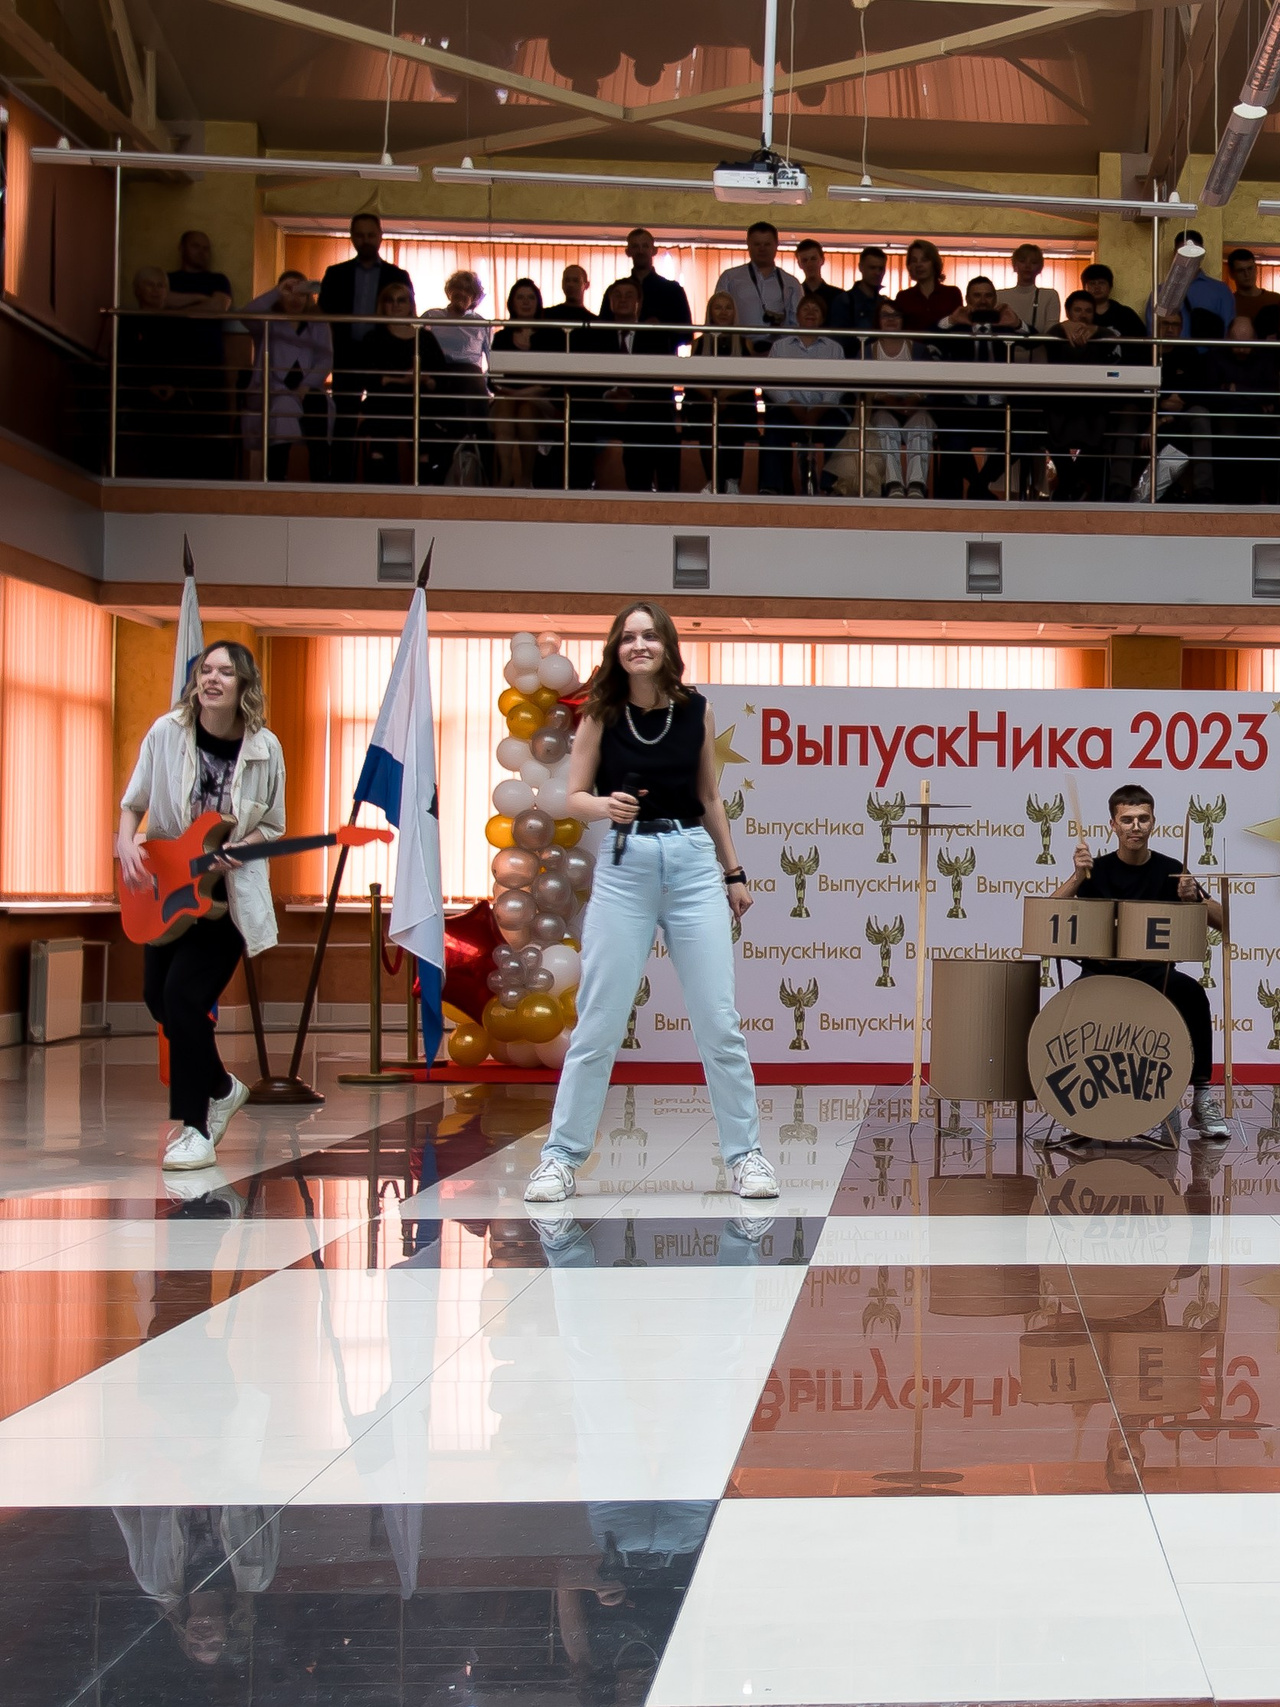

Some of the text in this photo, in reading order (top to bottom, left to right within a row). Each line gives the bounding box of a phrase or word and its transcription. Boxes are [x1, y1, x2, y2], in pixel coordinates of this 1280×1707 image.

[761, 708, 1268, 787] ВыпускНика 2023
[745, 817, 864, 841] ВыпускНика
[977, 876, 1064, 900] ВыпускН
[1049, 914, 1078, 945] 11
[743, 941, 862, 965] ВыпускНика
[905, 942, 1023, 960] ВпускНика
[1045, 1021, 1171, 1066] ПЕРШИКОВ
[1045, 1051, 1173, 1117] FOREVER
